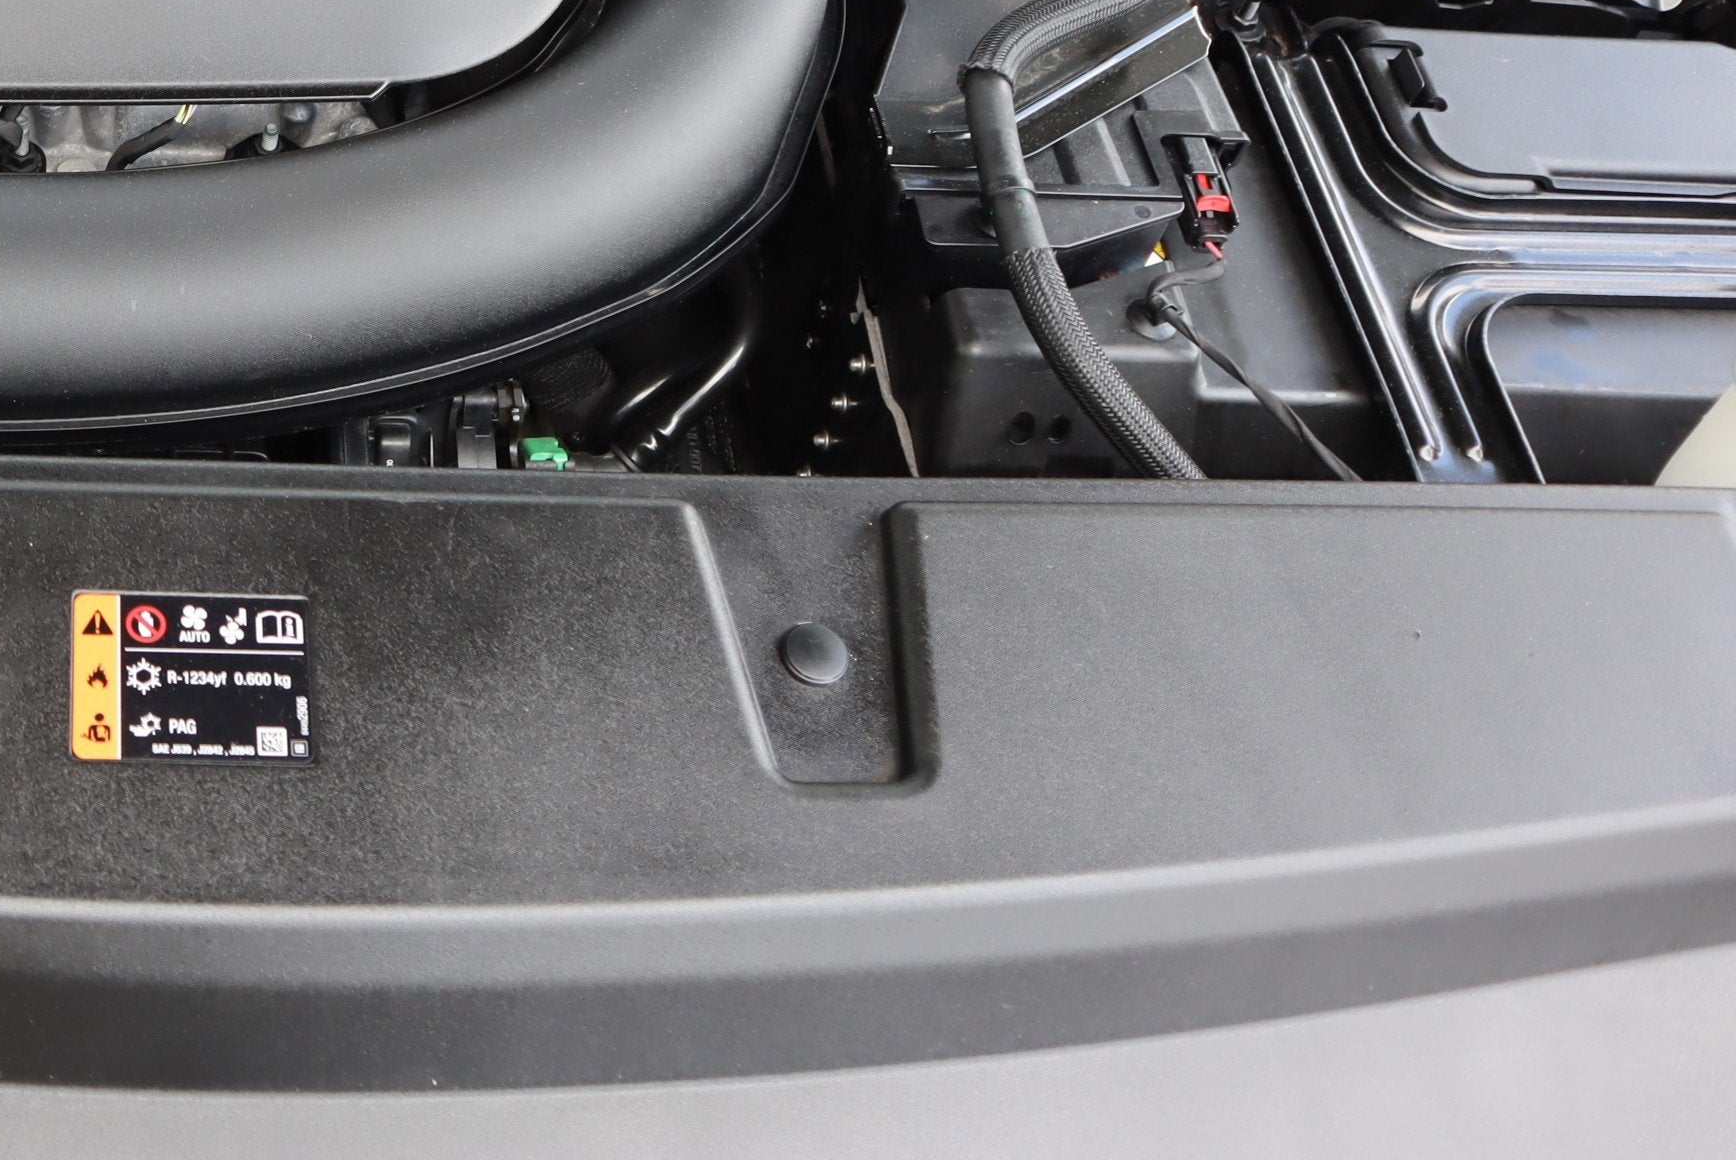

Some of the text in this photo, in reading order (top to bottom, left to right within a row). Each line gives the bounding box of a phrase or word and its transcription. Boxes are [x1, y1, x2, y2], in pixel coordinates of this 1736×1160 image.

[179, 630, 211, 643] AUTO
[167, 671, 292, 689] R-1234yf 0.600 kg
[168, 718, 197, 735] PAG
